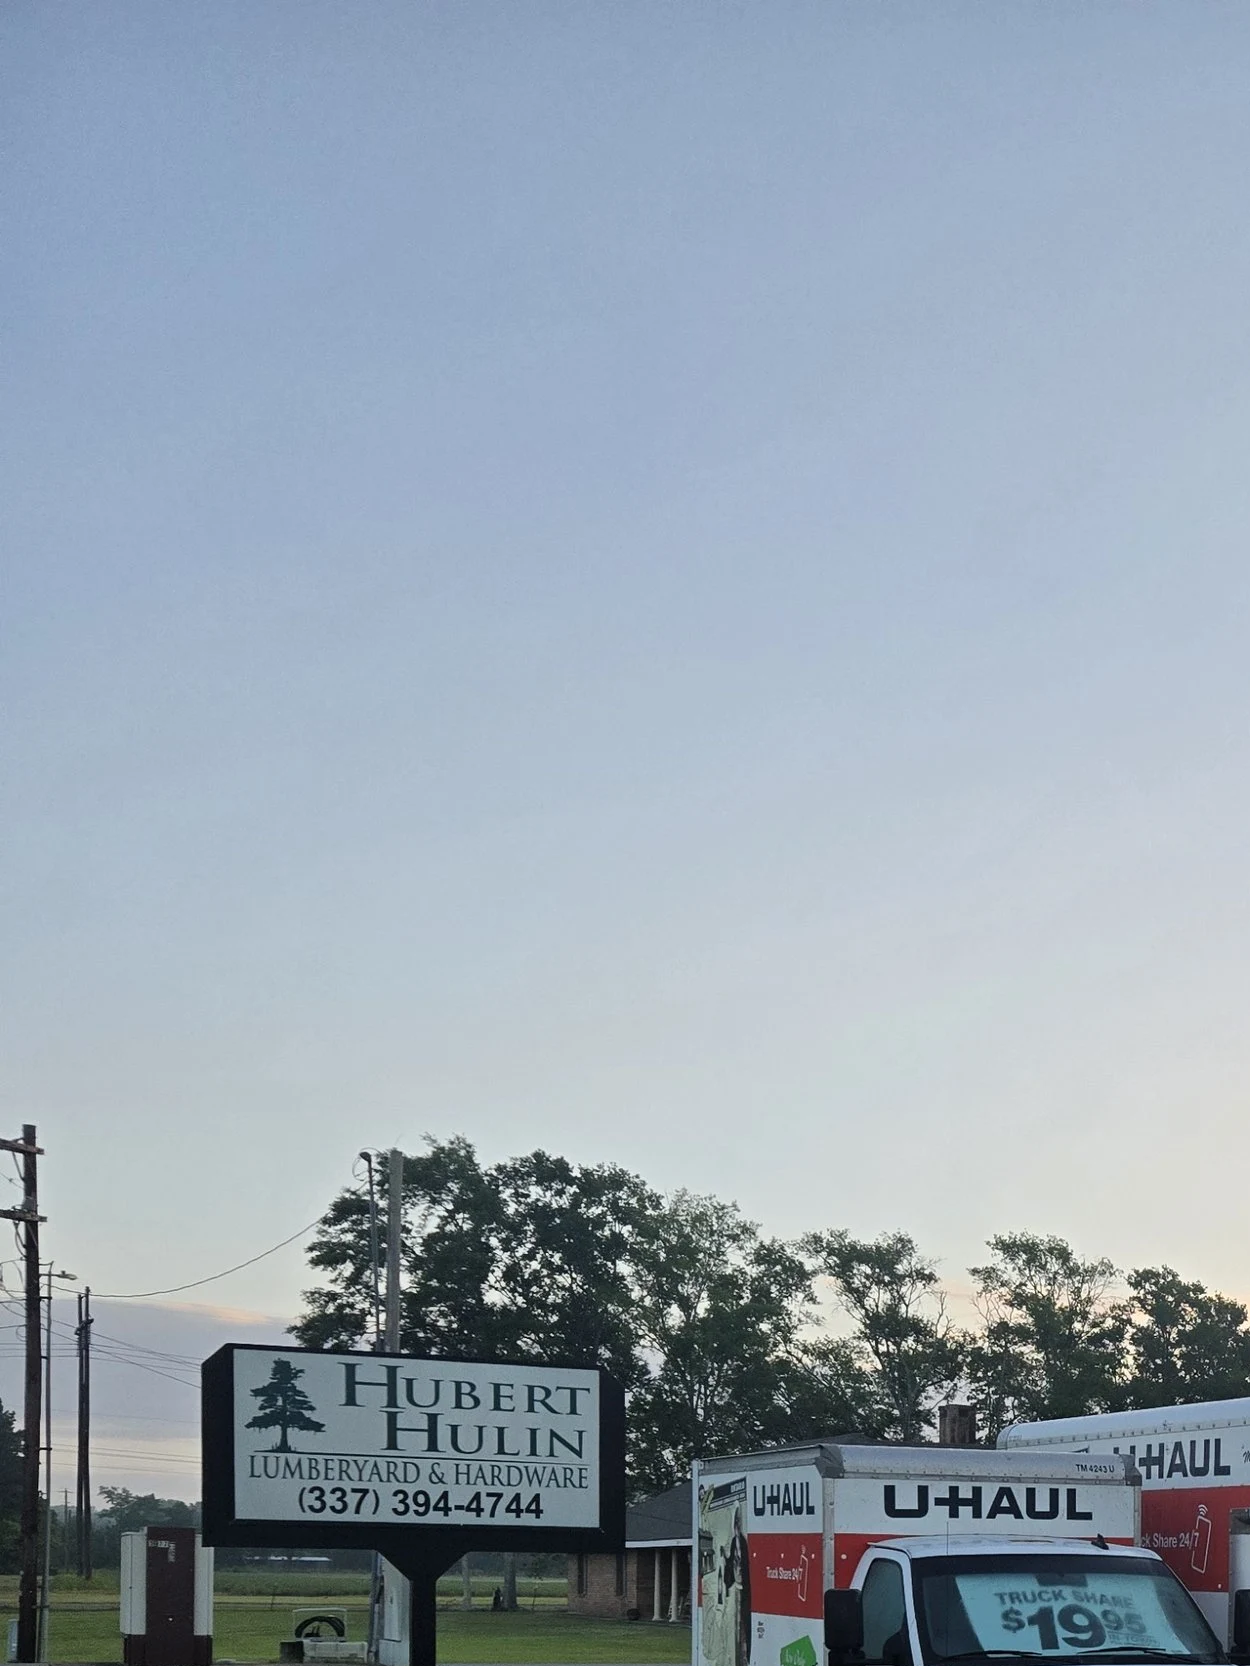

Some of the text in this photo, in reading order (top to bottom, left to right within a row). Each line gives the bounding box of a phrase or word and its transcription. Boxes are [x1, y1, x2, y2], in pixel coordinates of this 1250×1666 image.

[338, 1362, 591, 1416] HUBERT
[379, 1410, 587, 1459] HULIN
[248, 1454, 590, 1490] LUMBERYARD & HARDWARE
[1075, 1463, 1088, 1472] TM
[1109, 1464, 1115, 1473] U
[298, 1485, 544, 1520] (337) 394-4744
[753, 1481, 815, 1516] U-HAUL
[884, 1484, 1093, 1521] U-HAUL
[1152, 1532, 1178, 1548] Share
[1179, 1530, 1199, 1550] 24/7
[994, 1589, 1067, 1605] TRUCK
